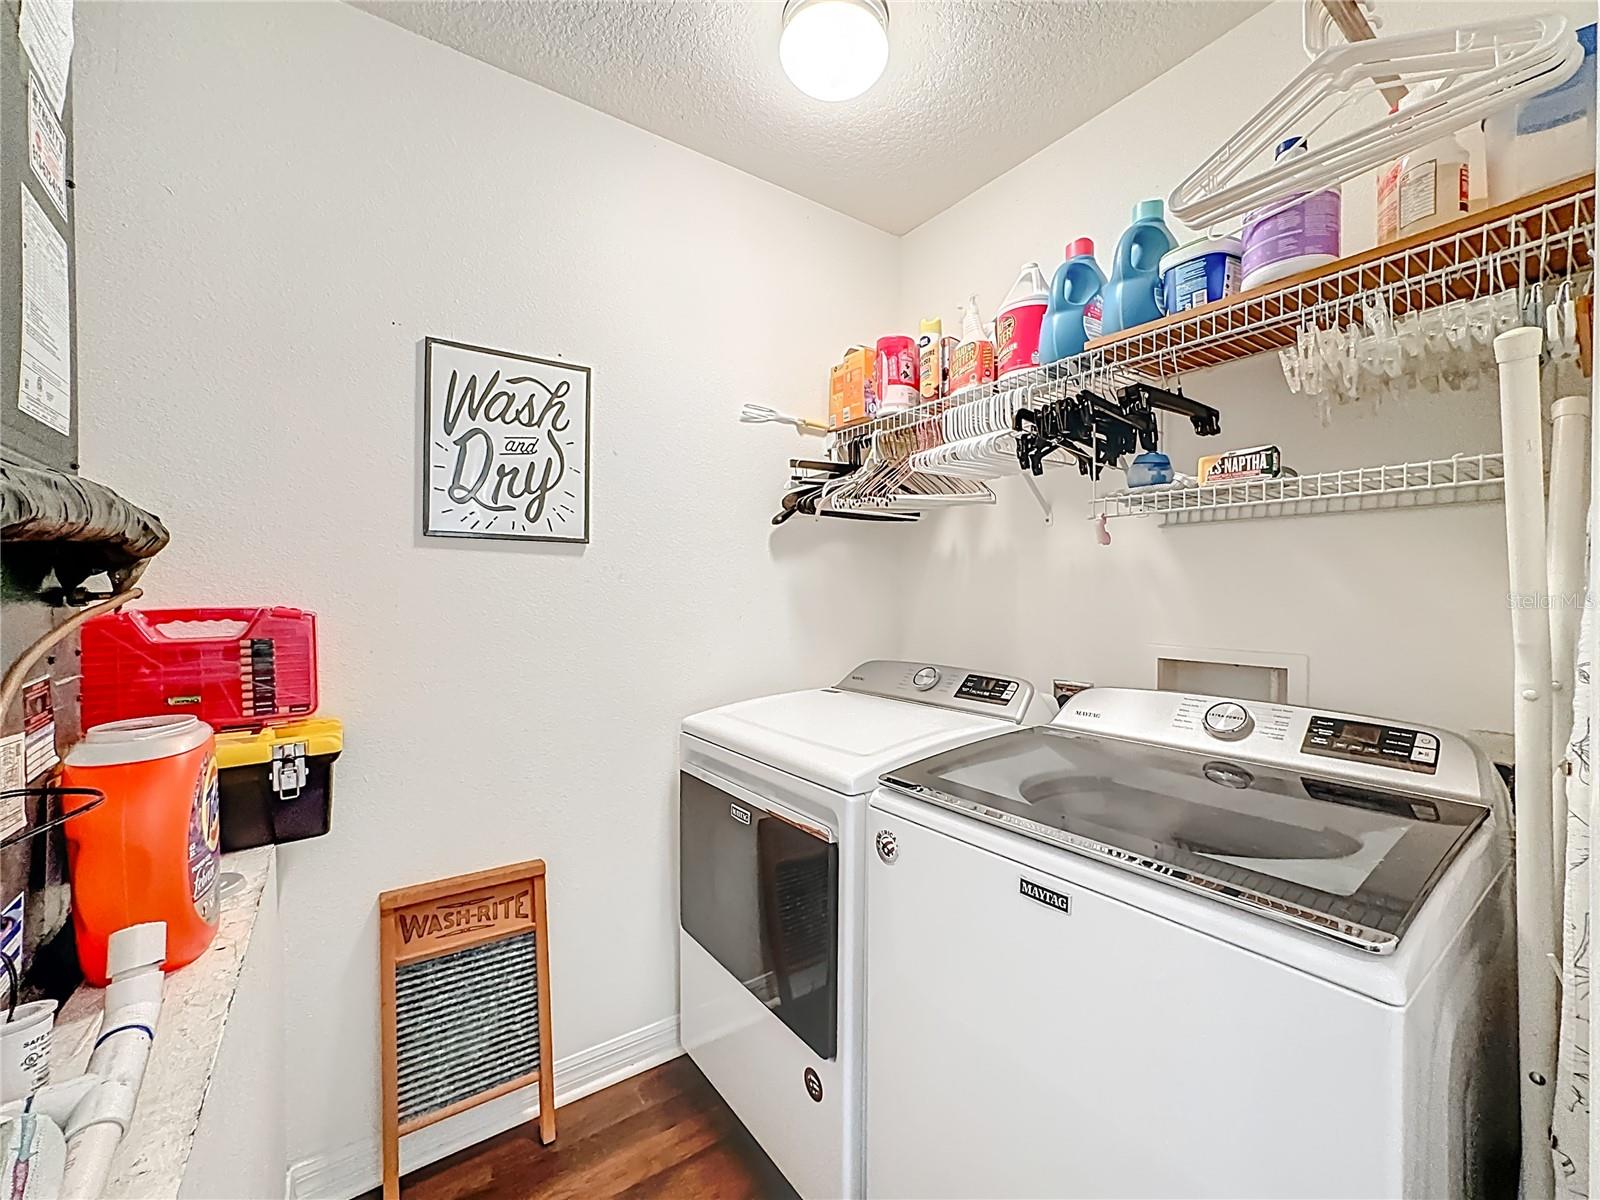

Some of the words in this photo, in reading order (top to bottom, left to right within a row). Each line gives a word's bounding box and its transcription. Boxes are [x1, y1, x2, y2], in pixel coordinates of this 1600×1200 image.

[444, 370, 570, 436] Wash
[504, 438, 539, 454] and
[448, 428, 564, 523] Dry
[400, 890, 529, 944] WASH-RITE
[1021, 881, 1067, 911] MAYTAG
[23, 1031, 51, 1049] SAFET
